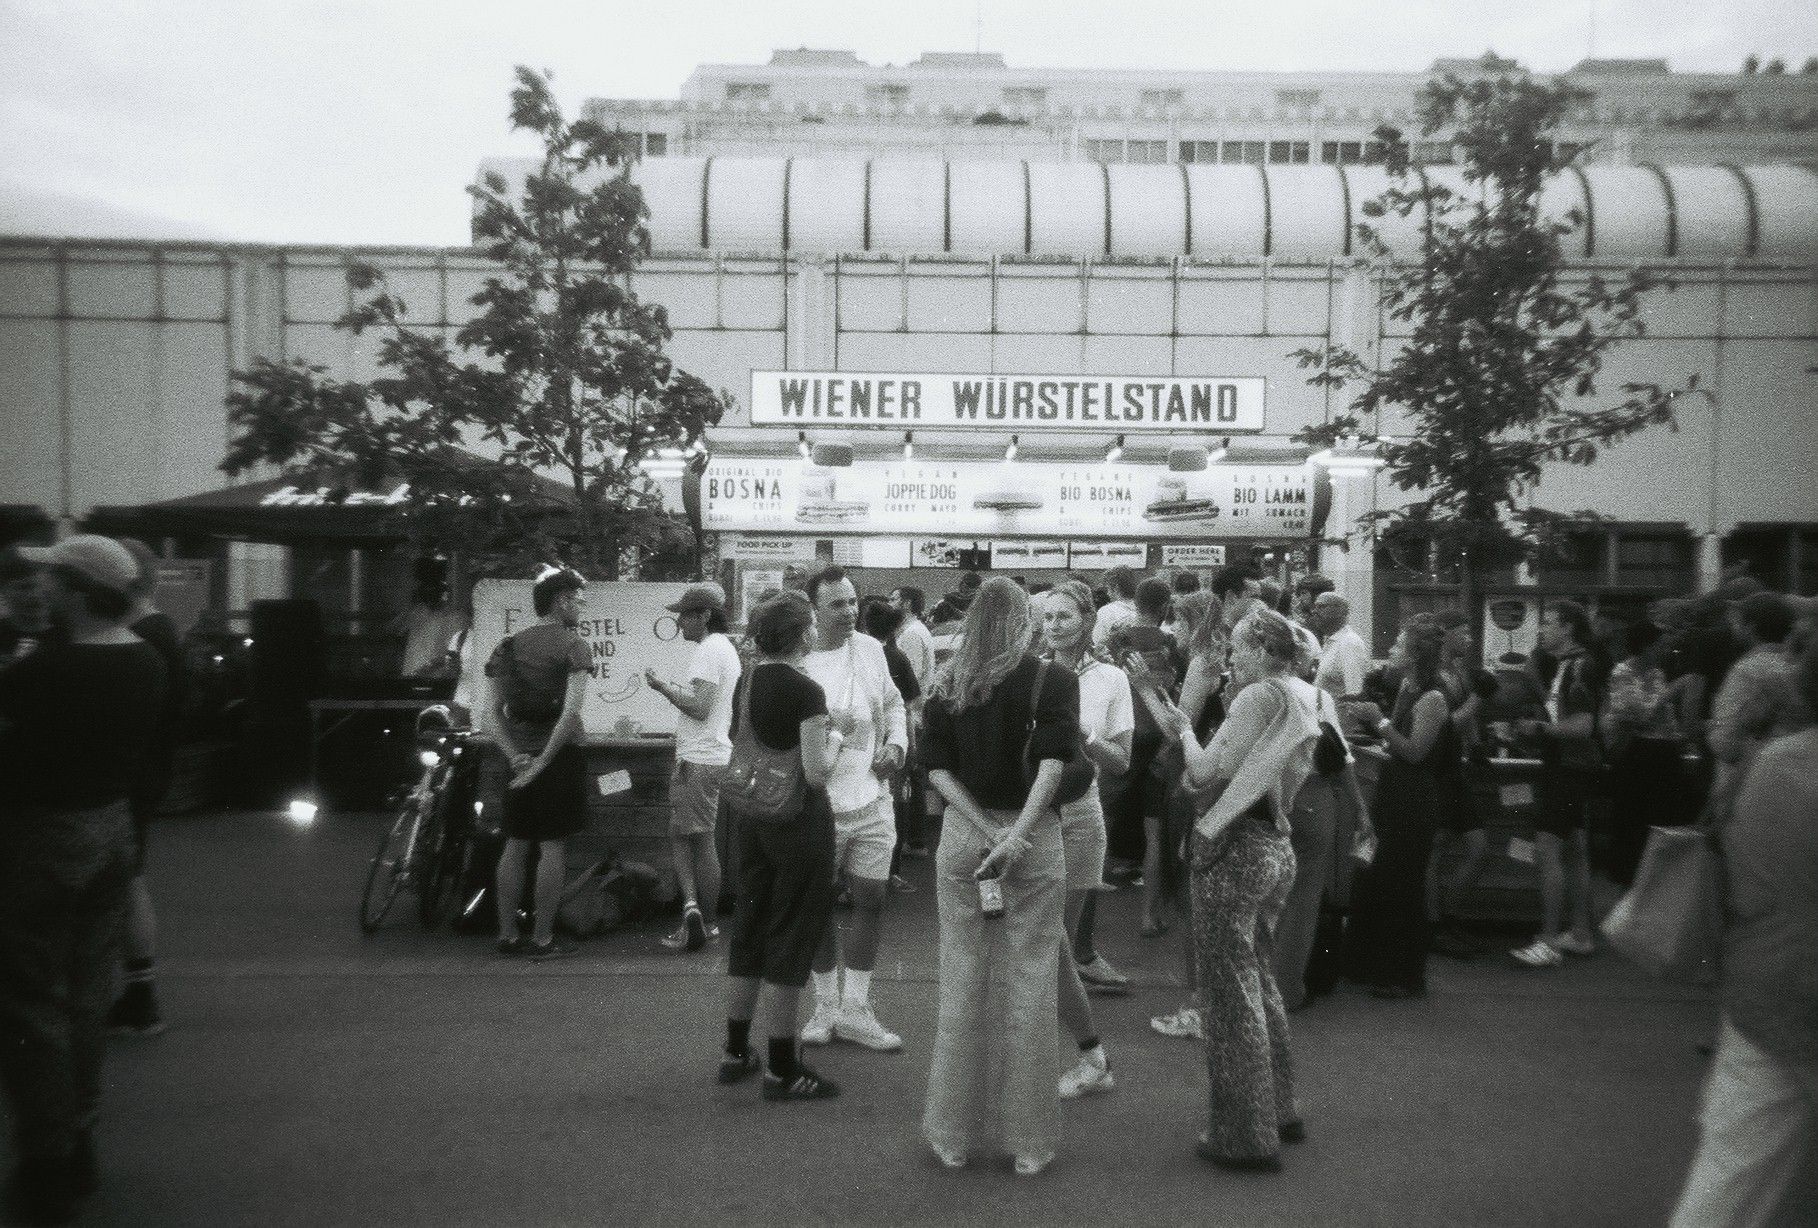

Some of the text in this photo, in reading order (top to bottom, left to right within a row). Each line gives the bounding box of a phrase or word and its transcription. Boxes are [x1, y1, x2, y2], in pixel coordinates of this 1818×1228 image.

[778, 377, 1239, 423] WIENER WÜRSTELSTAND
[708, 467, 783, 476] ORIGINAL BIO
[708, 478, 782, 499] BOSNA
[884, 483, 957, 500] JOPPIE DOG
[1060, 486, 1132, 501] BIO BOSNA
[1233, 488, 1306, 503] BIO LAMM
[884, 504, 957, 512] CURRY MAYO
[1102, 506, 1132, 515] CHIPS
[736, 541, 760, 549] FOOD
[572, 618, 625, 638] STEL
[591, 640, 617, 658] ND
